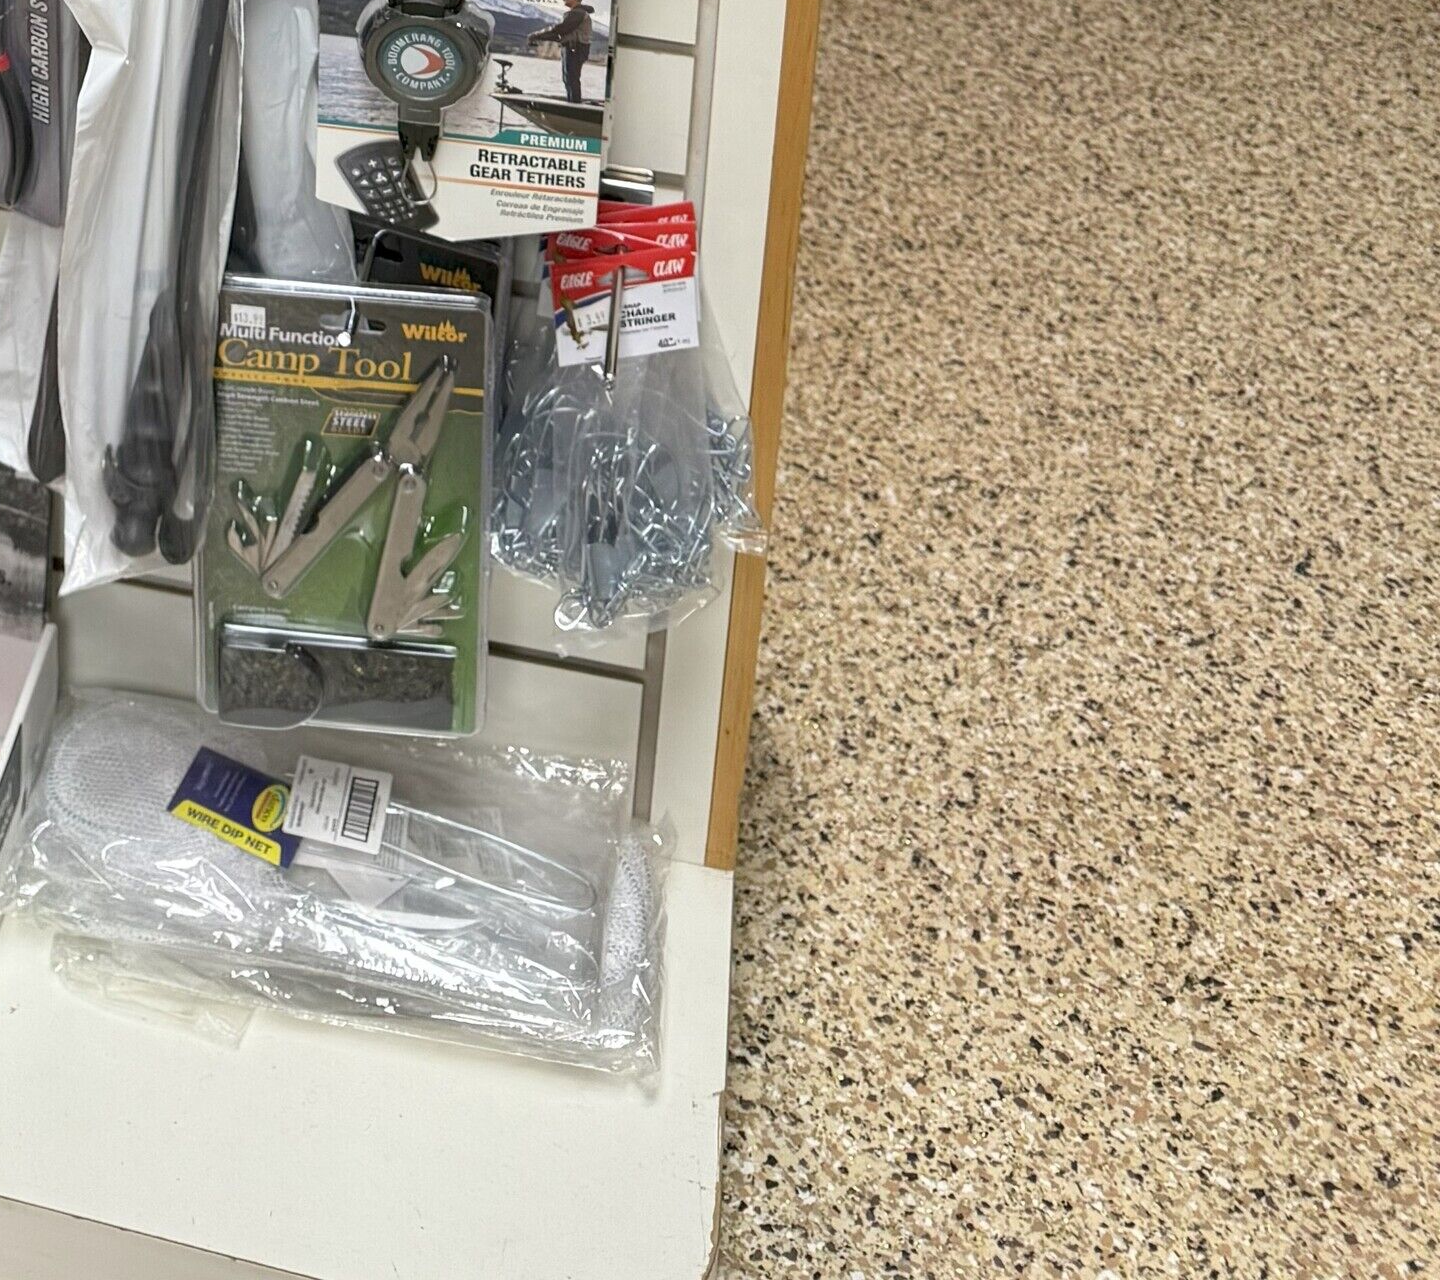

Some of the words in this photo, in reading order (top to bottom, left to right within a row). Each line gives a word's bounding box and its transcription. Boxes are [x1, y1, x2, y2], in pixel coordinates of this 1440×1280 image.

[29, 12, 50, 85] CARBON
[31, 87, 51, 126] HIGH
[520, 133, 587, 151] PREMIUM
[478, 148, 587, 173] RETRACTABLE
[469, 164, 511, 181] GEAR
[516, 169, 586, 189] TETHERS
[560, 271, 594, 289] EAGLE
[653, 258, 685, 277] CLAW
[219, 323, 266, 340] Multi
[402, 320, 468, 343] Wilcor
[620, 312, 676, 328] STRINGER
[218, 338, 320, 376] Camp
[328, 347, 412, 380] Tool
[186, 806, 219, 831] WIRE
[221, 822, 244, 843] DIP
[245, 834, 273, 855] NET
